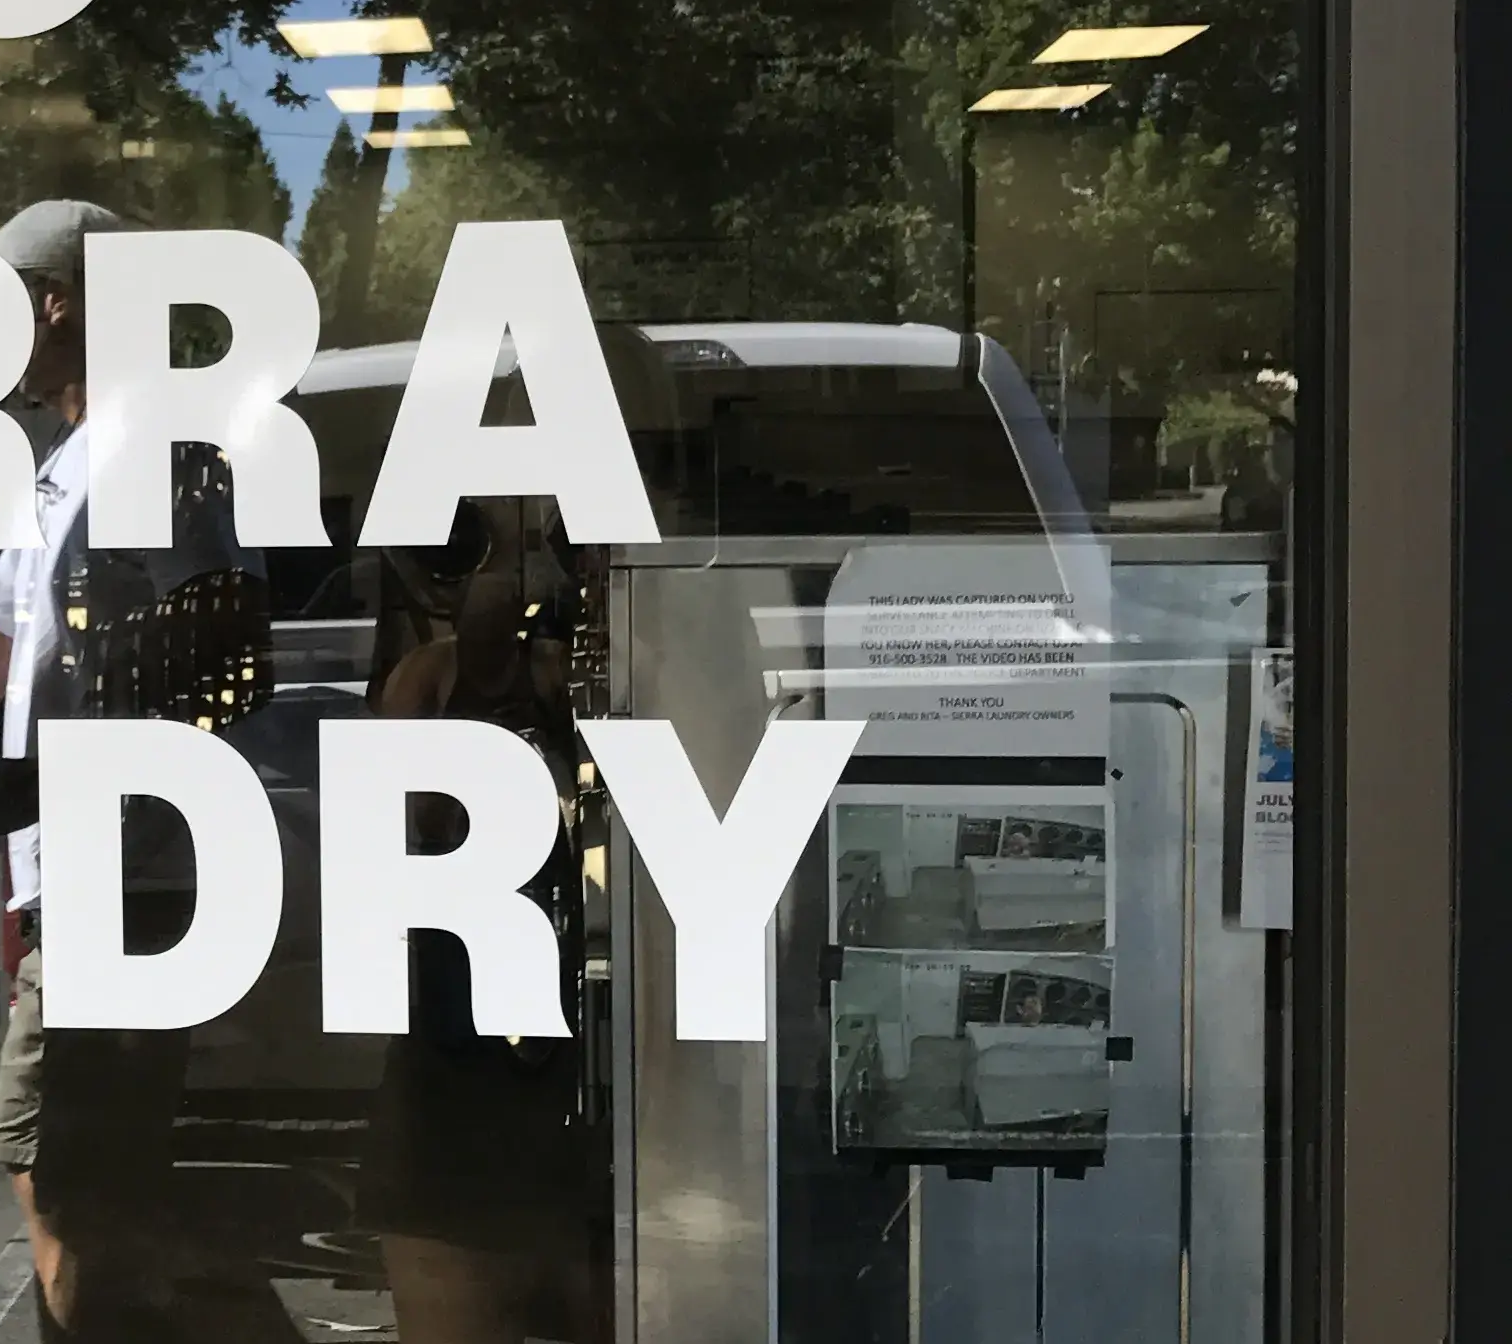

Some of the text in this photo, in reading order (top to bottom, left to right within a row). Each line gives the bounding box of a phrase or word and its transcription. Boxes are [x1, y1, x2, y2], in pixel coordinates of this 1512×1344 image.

[868, 596, 894, 606] THIS
[927, 595, 953, 605] WAS
[1018, 594, 1036, 603] ON
[1038, 593, 1075, 603] VIDEO
[954, 639, 994, 649] PLEASE
[956, 653, 978, 664] THE
[980, 652, 1017, 664] VIDEO
[1019, 652, 1042, 664] HAS
[1044, 652, 1075, 664] BEEN
[938, 697, 1005, 708] THANK YOU
